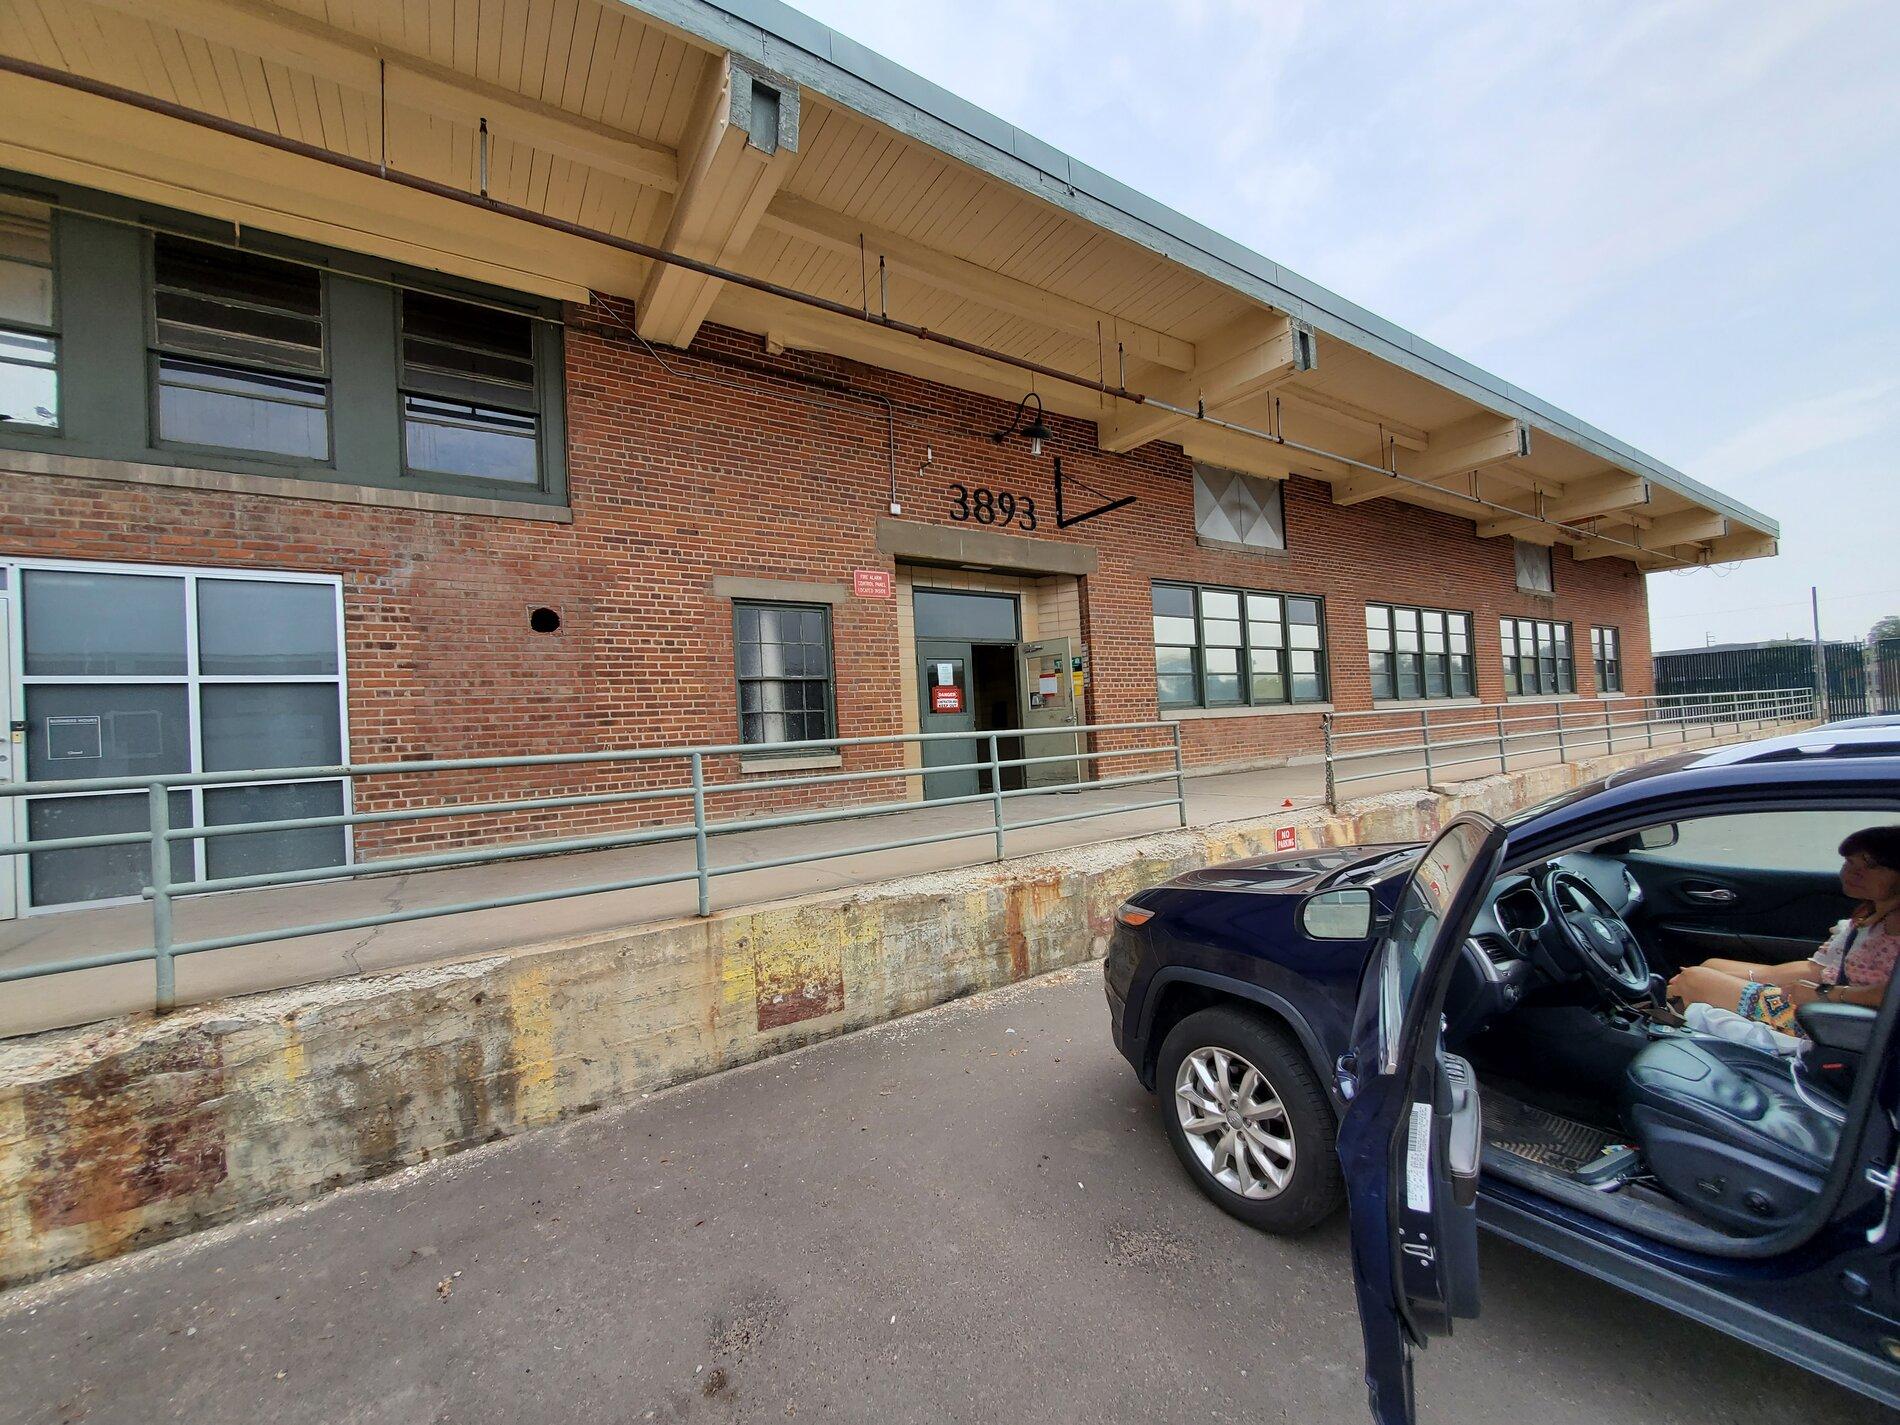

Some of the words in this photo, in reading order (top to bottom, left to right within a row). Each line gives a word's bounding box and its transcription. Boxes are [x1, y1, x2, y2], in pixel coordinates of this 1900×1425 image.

[950, 484, 1037, 531] 3893
[1281, 830, 1290, 839] NO
[1278, 838, 1294, 848] PARKING
